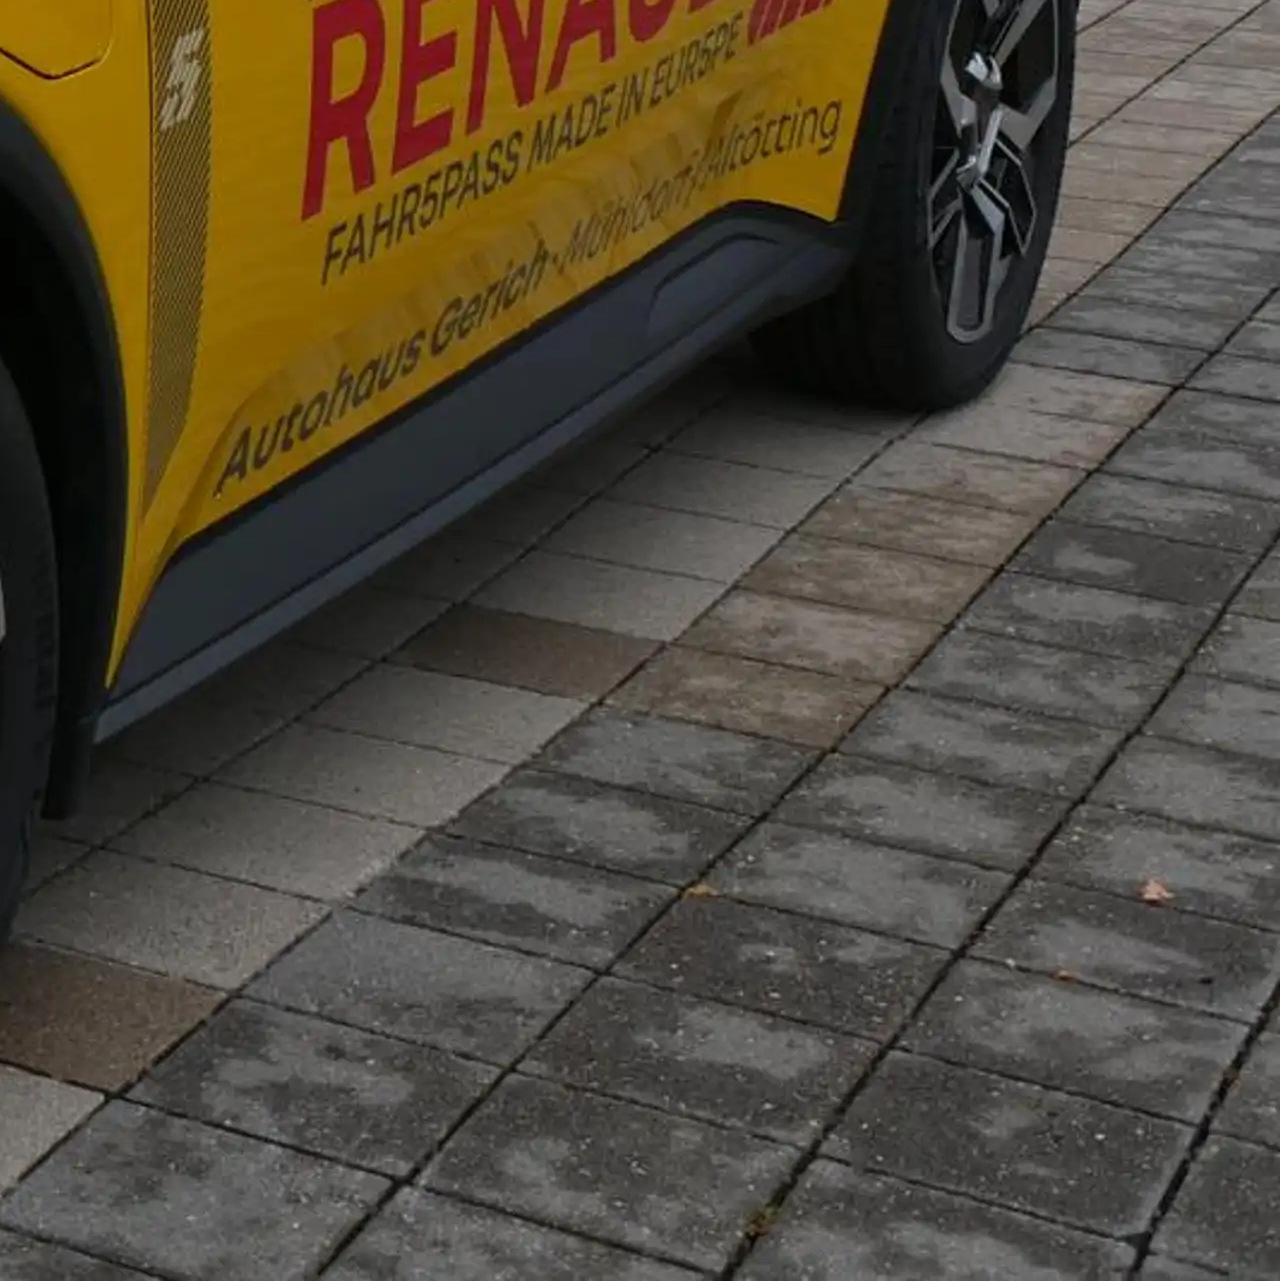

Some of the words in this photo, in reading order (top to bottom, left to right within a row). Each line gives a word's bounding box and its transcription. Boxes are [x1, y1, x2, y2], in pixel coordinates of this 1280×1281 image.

[321, 131, 523, 287] FAHR5PASS
[527, 82, 617, 175] MADE
[616, 64, 649, 128] IN
[213, 327, 428, 498] Autohaus
[431, 237, 550, 356] Gerich
